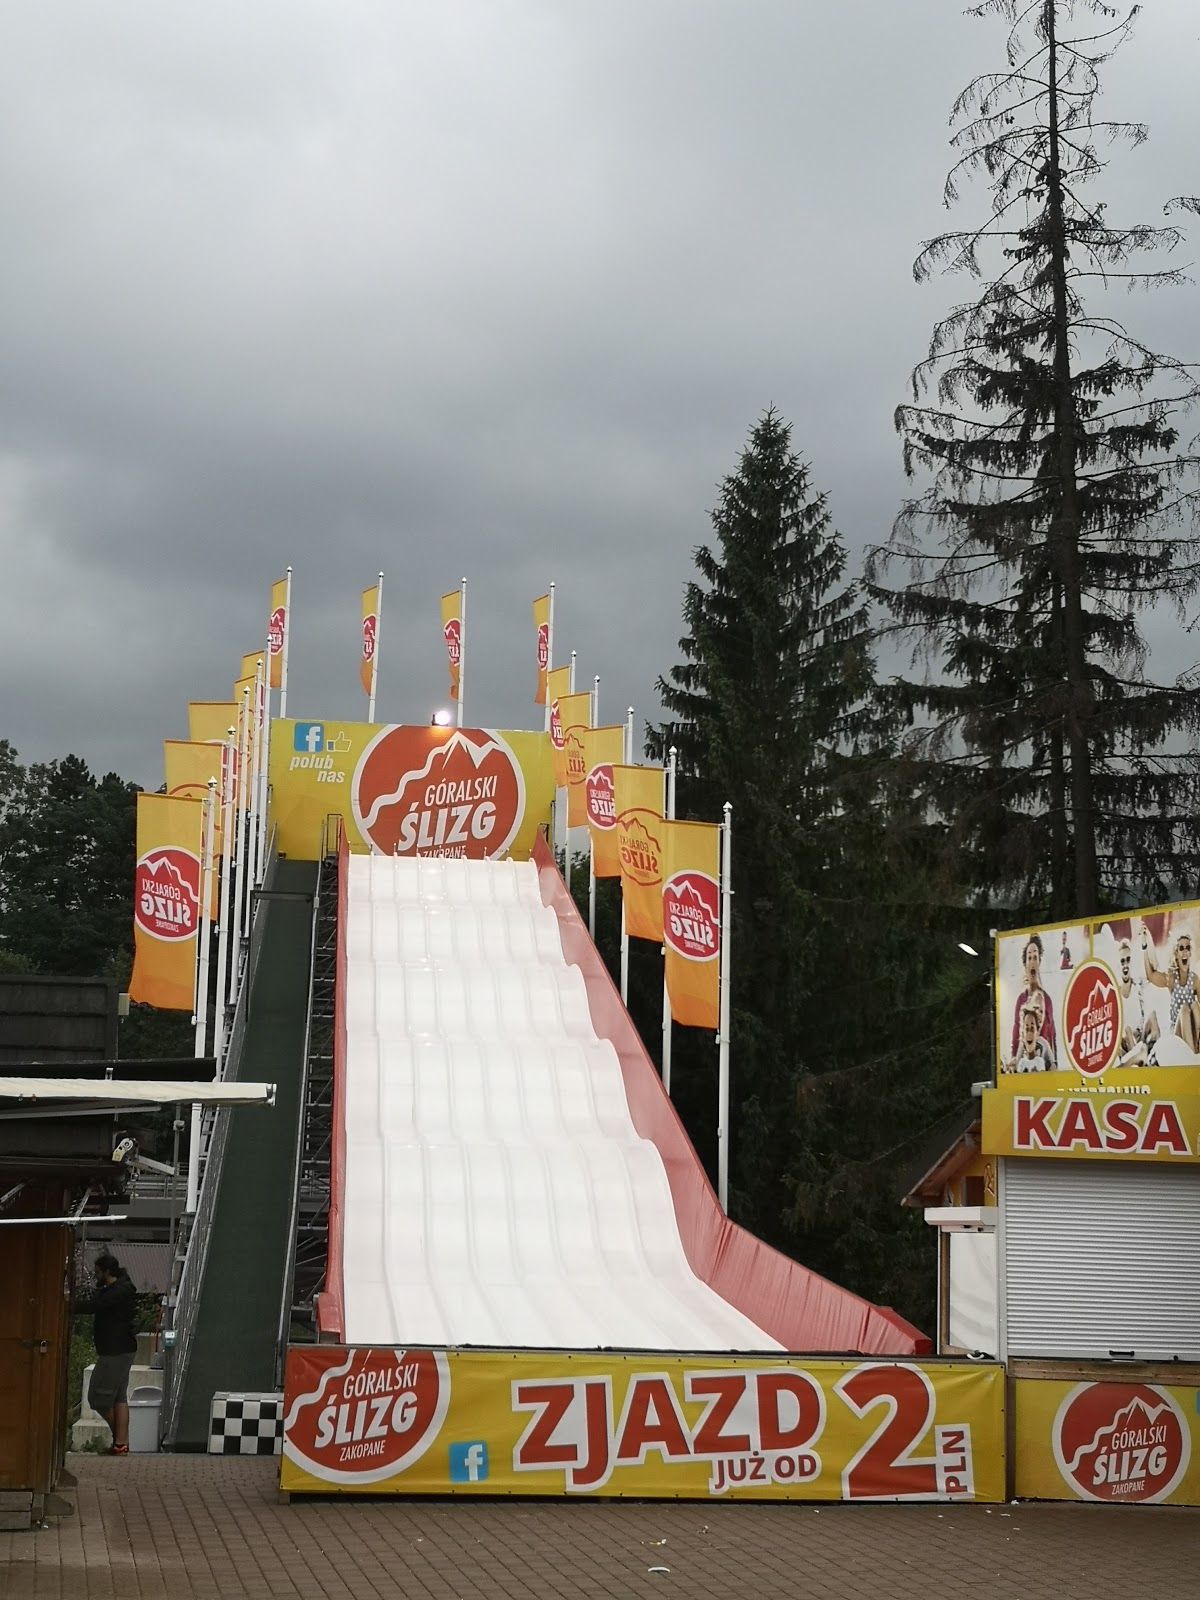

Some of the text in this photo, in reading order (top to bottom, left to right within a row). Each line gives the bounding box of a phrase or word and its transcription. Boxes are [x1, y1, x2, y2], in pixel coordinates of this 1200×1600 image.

[290, 754, 333, 771] polub
[317, 769, 345, 783] nas
[424, 776, 497, 806] GÓRALSKI
[398, 801, 496, 851] ŚLIZG
[1080, 1020, 1113, 1060] ŚLIZG
[1015, 1098, 1190, 1154] KASA
[343, 1363, 419, 1400] GÓRALSKI
[314, 1391, 419, 1449] ŚLIZG
[513, 1369, 824, 1488] ZJAZD
[836, 1364, 938, 1499] 2
[1111, 1425, 1167, 1451] GÓRALSKI
[339, 1440, 386, 1463] ZAKOPANE
[714, 1450, 817, 1490] JUŻ OD
[941, 1429, 968, 1494] PLN
[1092, 1445, 1168, 1486] ŚLIZG
[1111, 1480, 1146, 1496] ZAKOPANE
